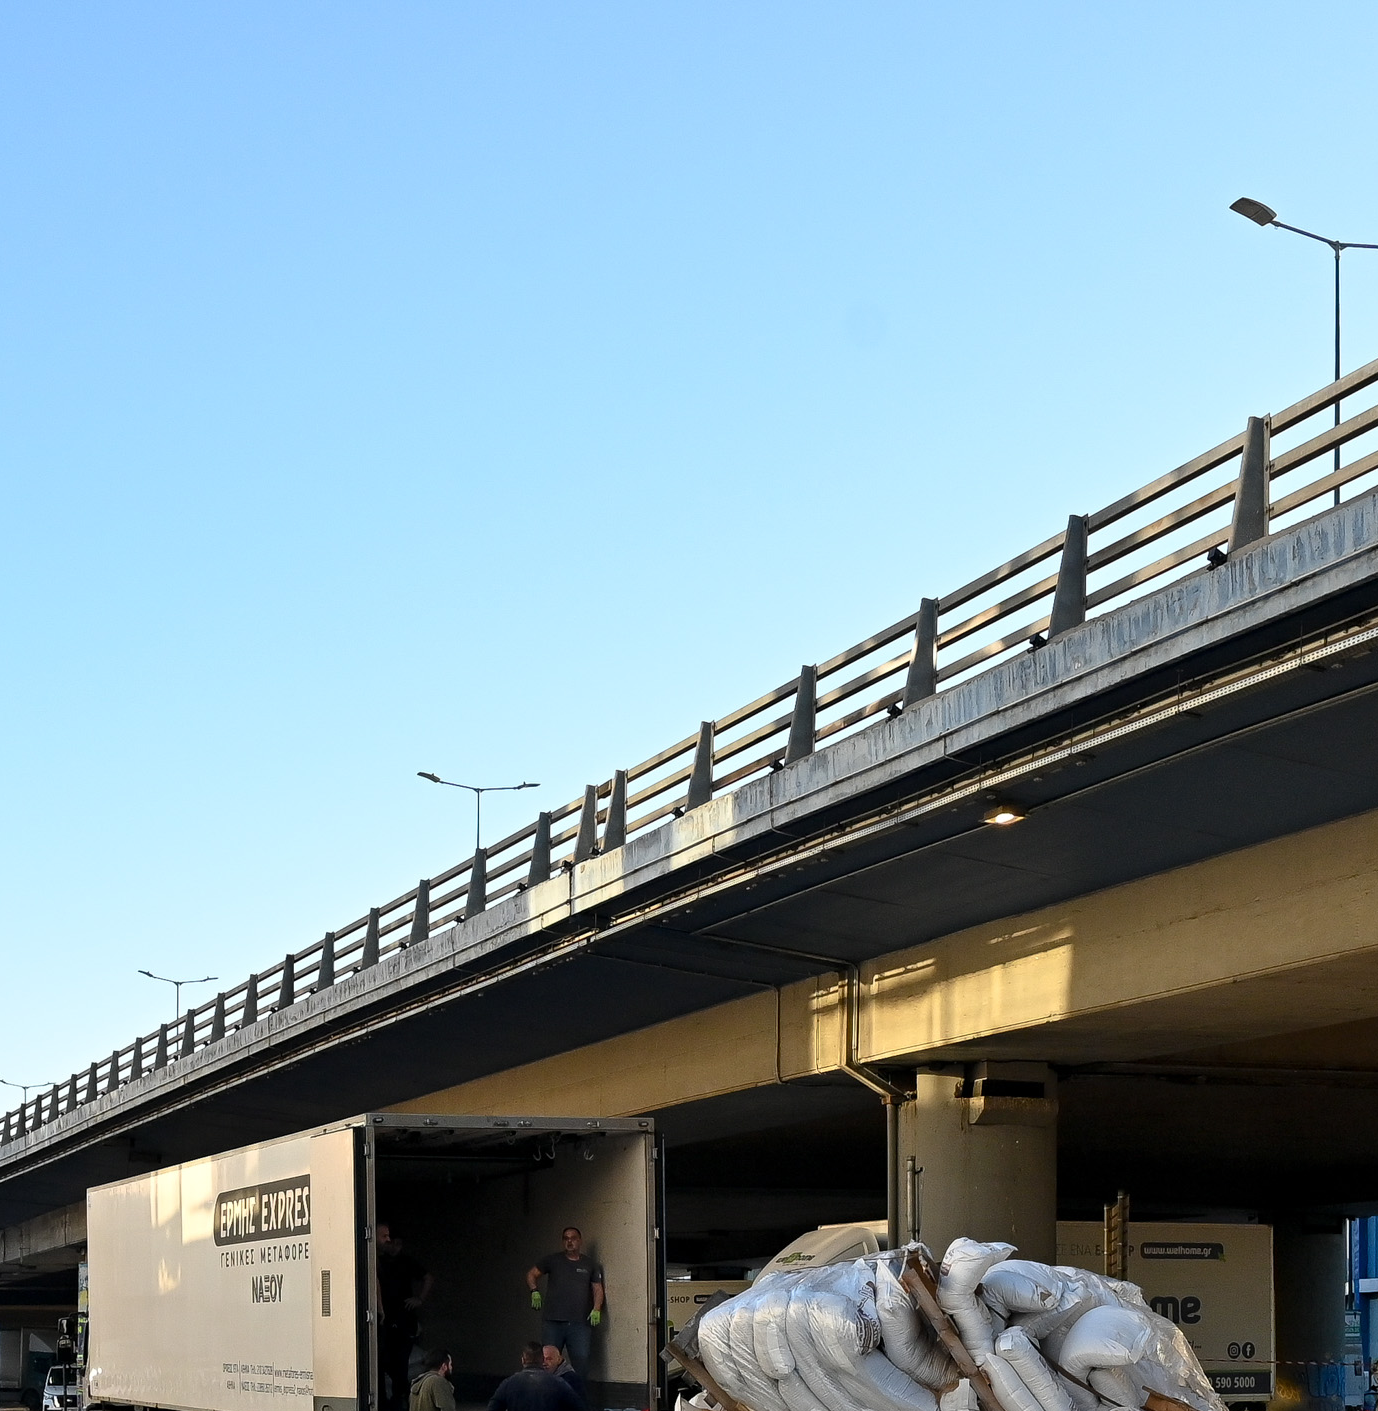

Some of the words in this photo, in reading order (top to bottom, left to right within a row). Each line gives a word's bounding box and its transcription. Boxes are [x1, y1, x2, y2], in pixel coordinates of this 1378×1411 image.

[220, 1197, 256, 1238] ΕΡΜΗΣ
[262, 1186, 309, 1232] EXPRES
[221, 1249, 254, 1268] ΓΕΝΙΚΕΣ
[260, 1242, 309, 1263] ΜΕΤΑΦΟΡΕ
[1143, 1245, 1212, 1258] www.welhome.gr
[251, 1274, 283, 1303] ΝΑΞΟΥ
[1215, 1376, 1232, 1388] 590
[1234, 1376, 1256, 1388] 5000
